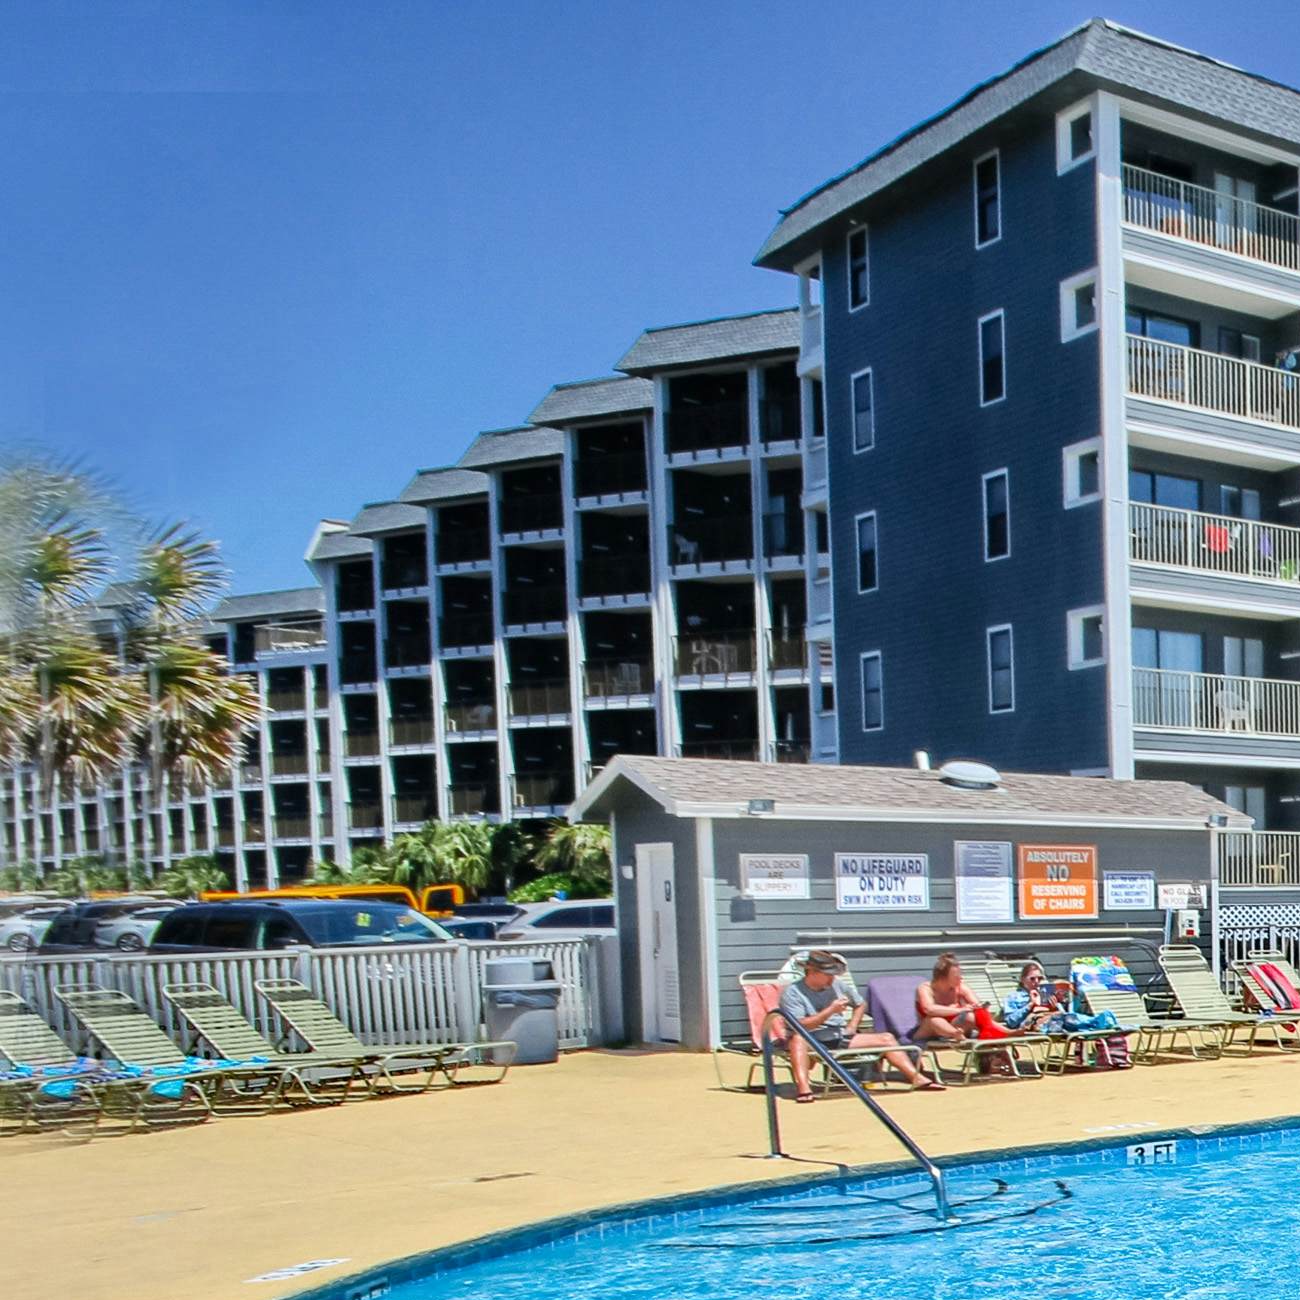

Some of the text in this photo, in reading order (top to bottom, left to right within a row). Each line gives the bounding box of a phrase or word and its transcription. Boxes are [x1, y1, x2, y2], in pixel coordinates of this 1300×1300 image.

[1027, 851, 1089, 863] ABSOLUTELY
[749, 859, 801, 870] POOL DECKS
[841, 859, 923, 875] NO LIFEGUARD
[767, 871, 785, 880] ARE
[1046, 865, 1070, 882] NO
[859, 876, 908, 891] ON DUTY
[1031, 885, 1087, 897] RESERVING
[843, 895, 923, 905] SWIM AT YOUR OWN RISK
[1033, 899, 1085, 911] OF CHAIRS
[1153, 1143, 1173, 1163] FT
